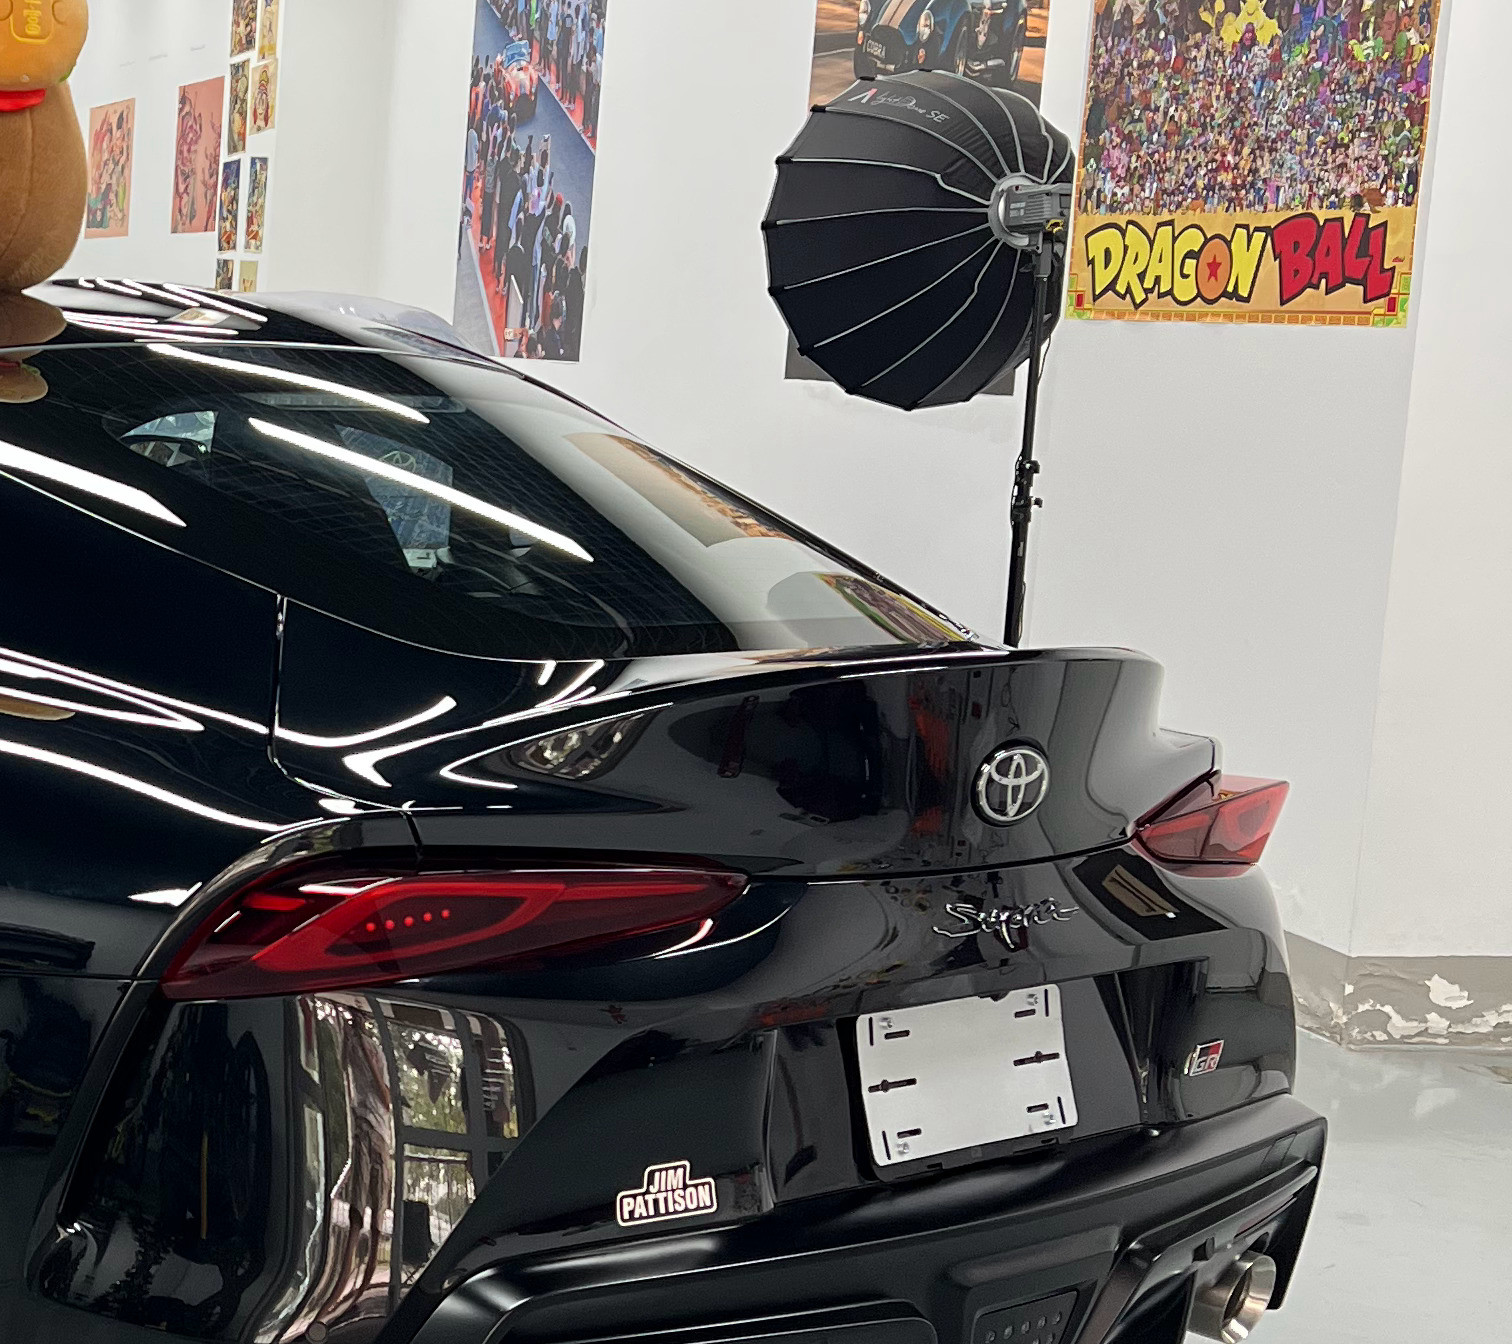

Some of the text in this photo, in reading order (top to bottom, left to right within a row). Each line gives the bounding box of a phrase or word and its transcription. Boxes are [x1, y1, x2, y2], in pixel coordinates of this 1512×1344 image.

[926, 110, 950, 123] SE
[1085, 211, 1396, 309] DRAGON BALL
[933, 897, 1080, 949] Supra
[649, 1167, 684, 1194] JIM
[622, 1184, 712, 1220] PATTISON
